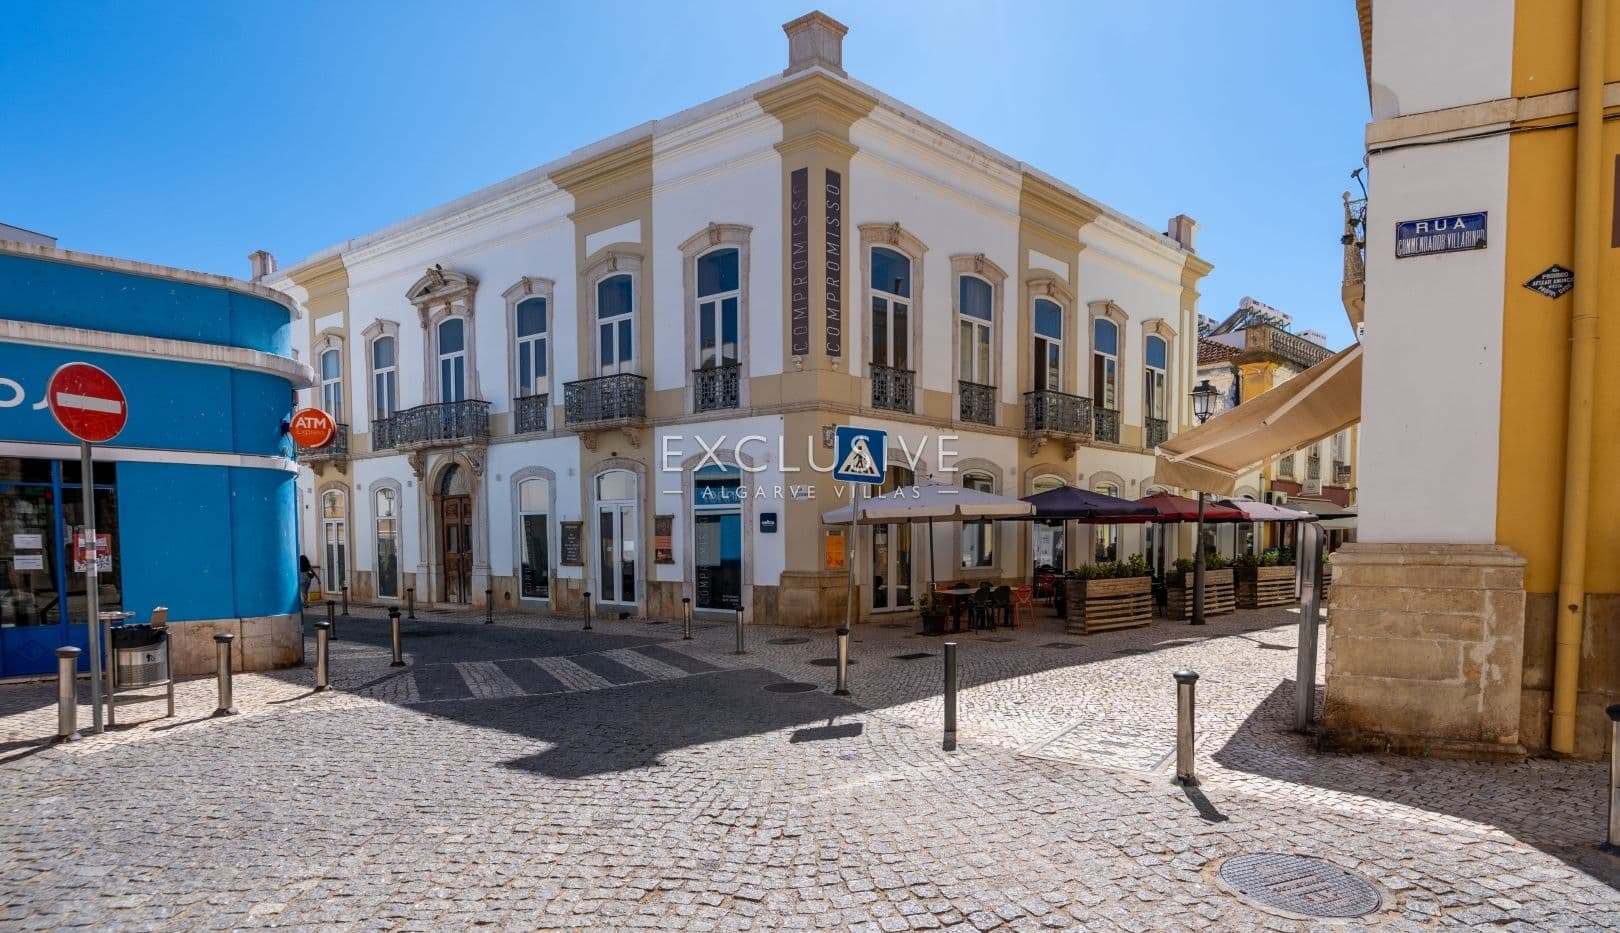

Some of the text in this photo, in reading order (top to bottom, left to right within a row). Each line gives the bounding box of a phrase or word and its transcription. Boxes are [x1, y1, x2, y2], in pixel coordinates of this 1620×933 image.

[793, 187, 808, 352] COMPROMISSO
[826, 184, 840, 352] COMPROMISSO
[1416, 217, 1466, 234] RUA
[295, 417, 326, 429] ATM
